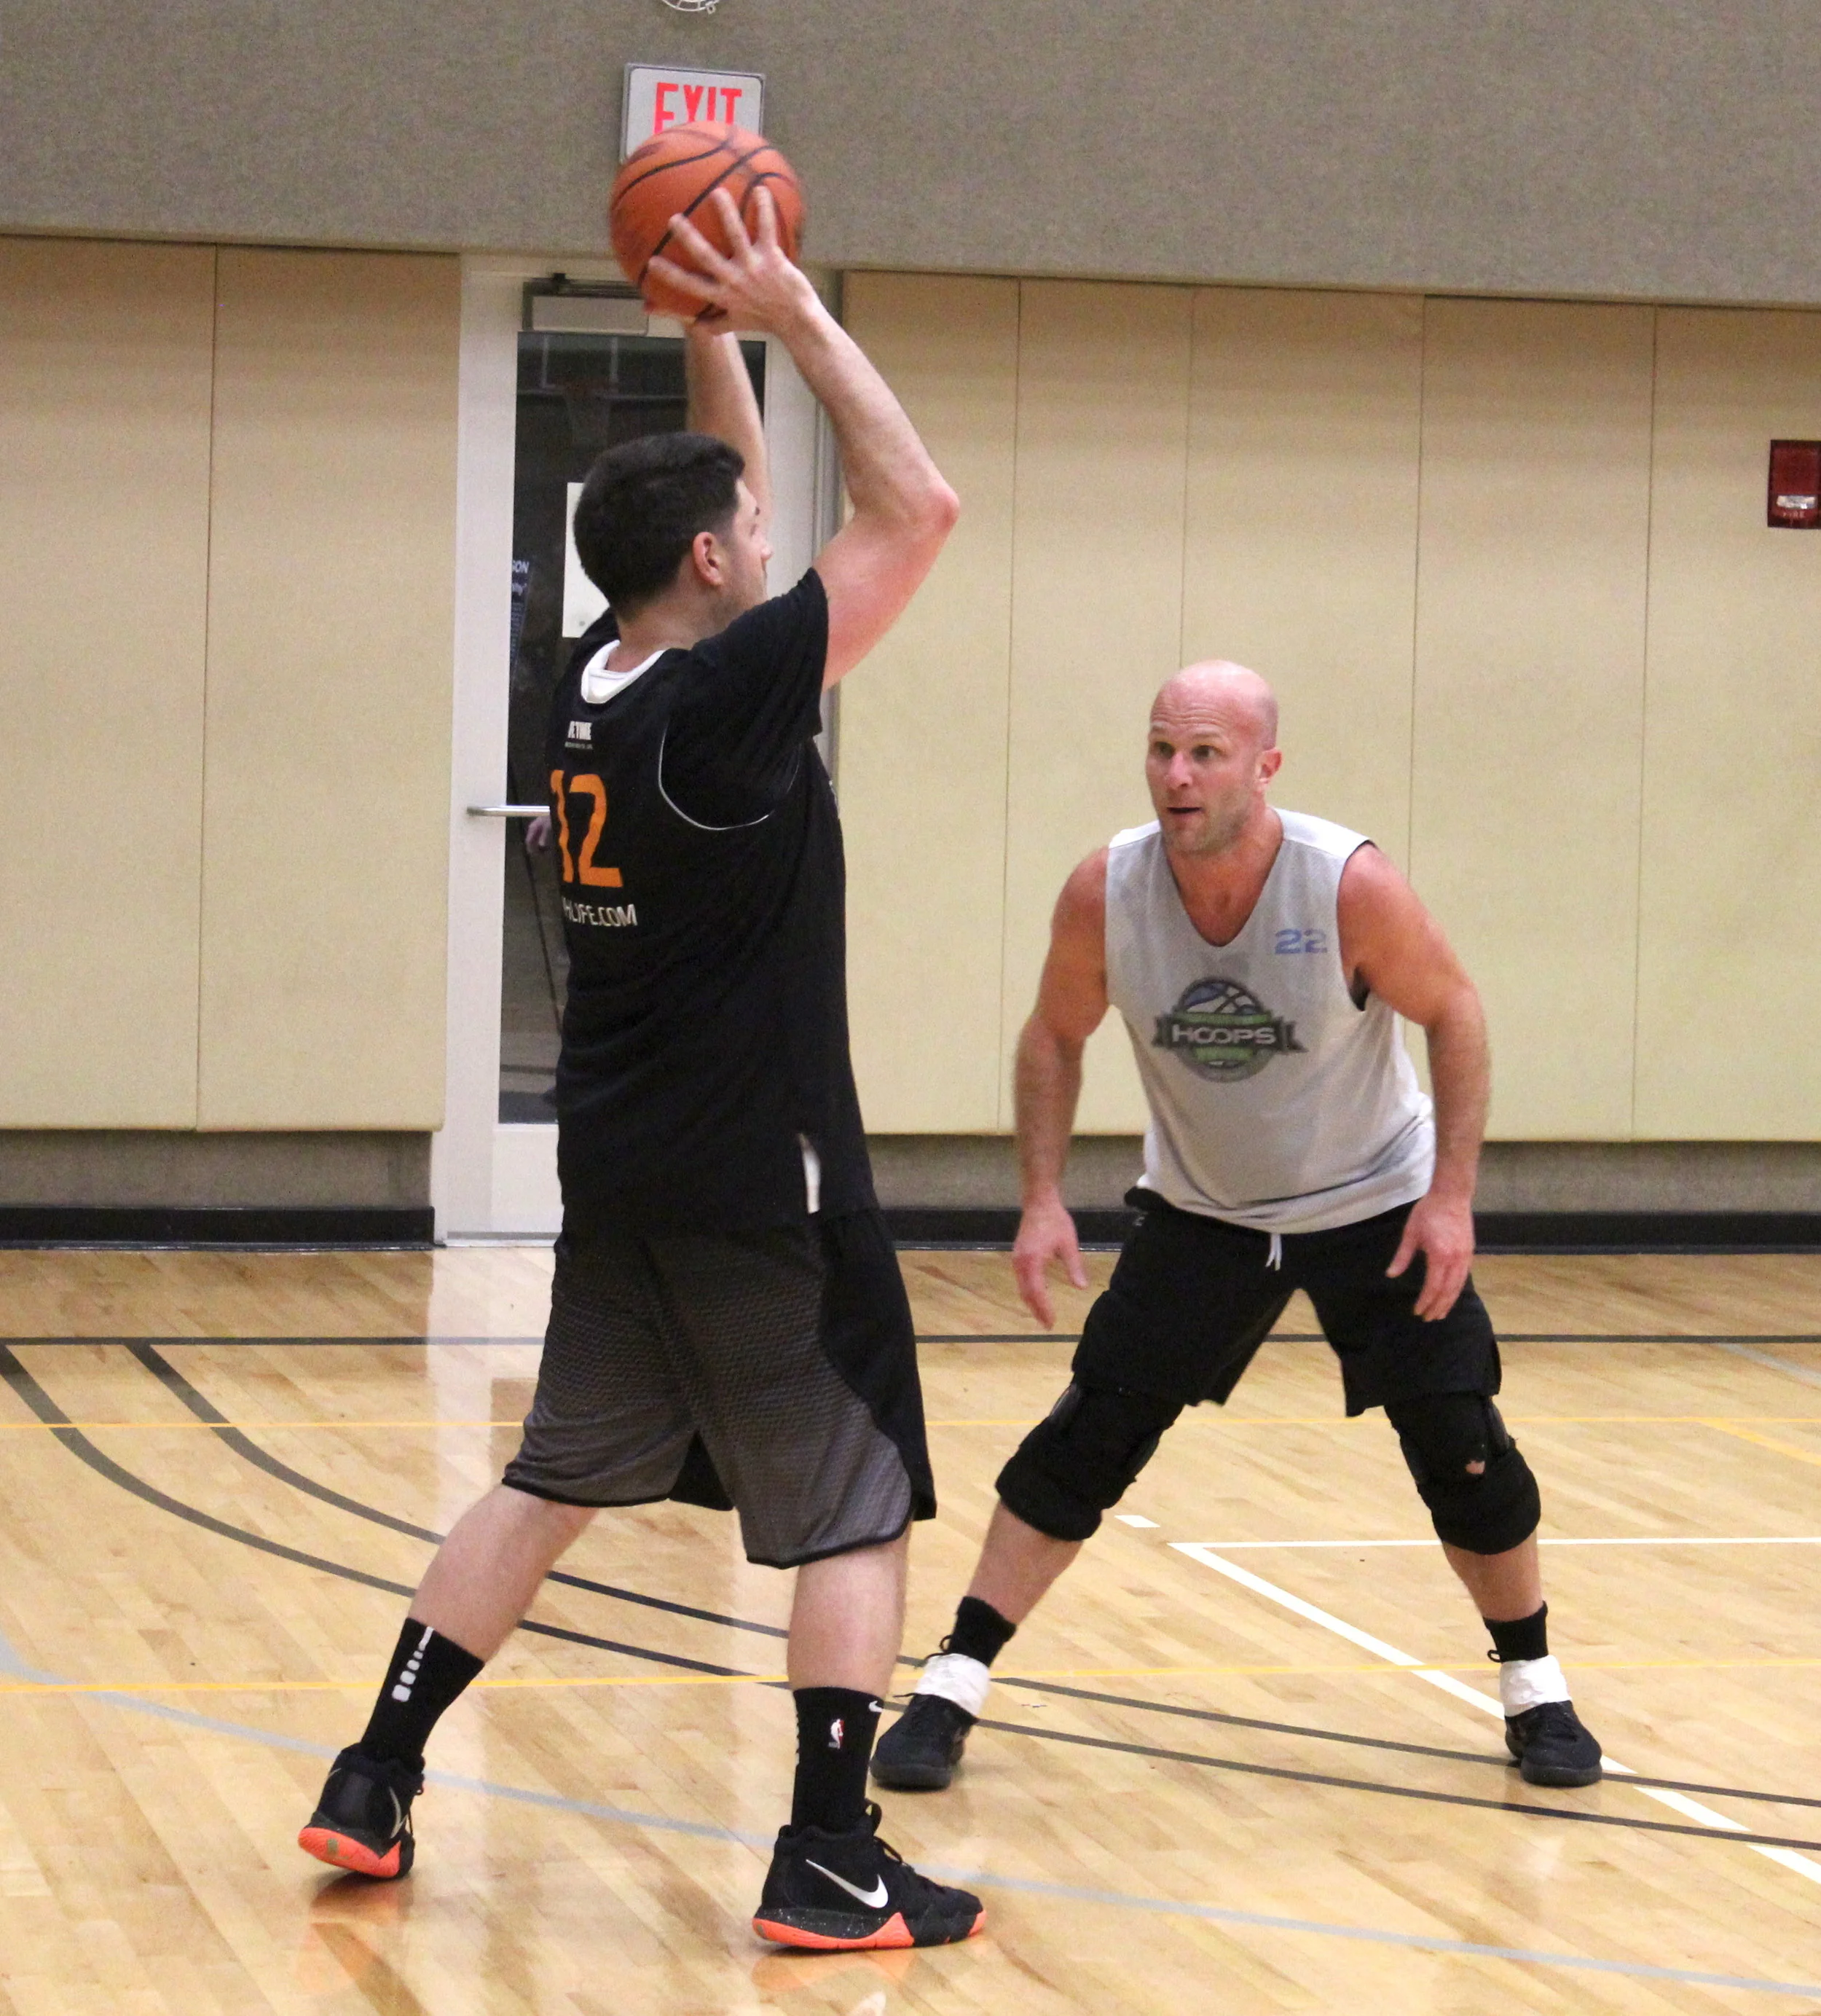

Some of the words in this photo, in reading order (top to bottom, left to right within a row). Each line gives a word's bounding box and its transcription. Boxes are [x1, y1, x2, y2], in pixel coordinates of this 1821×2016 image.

[551, 769, 624, 887] 12
[1275, 927, 1328, 955] 22
[1171, 1023, 1277, 1045] HOOPS
